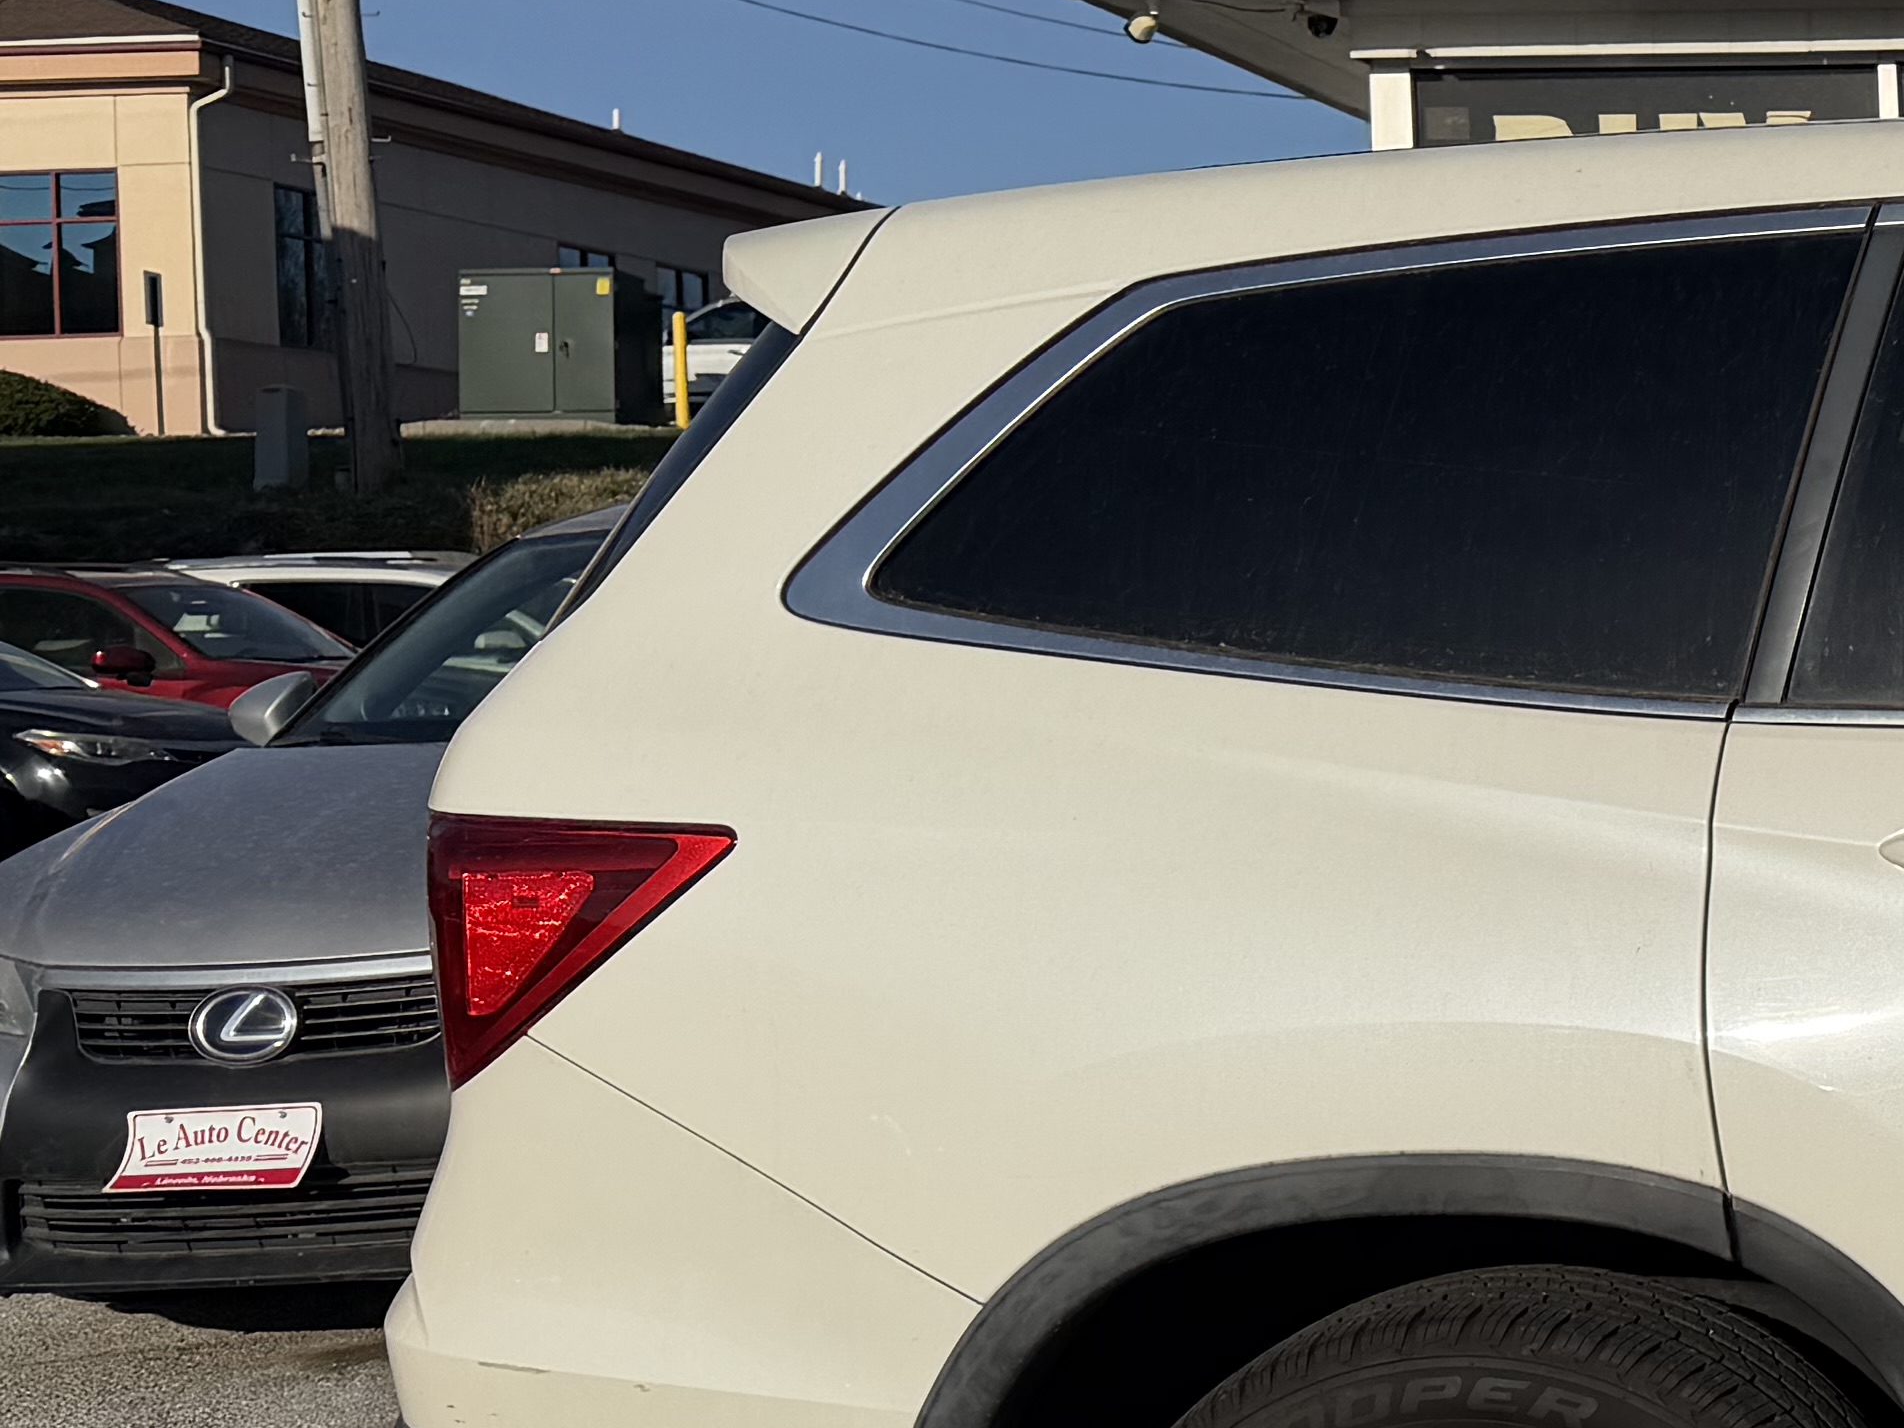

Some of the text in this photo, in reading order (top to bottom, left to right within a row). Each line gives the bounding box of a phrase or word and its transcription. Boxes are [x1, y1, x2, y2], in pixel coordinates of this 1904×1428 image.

[137, 1115, 309, 1162] Le Auto Center
